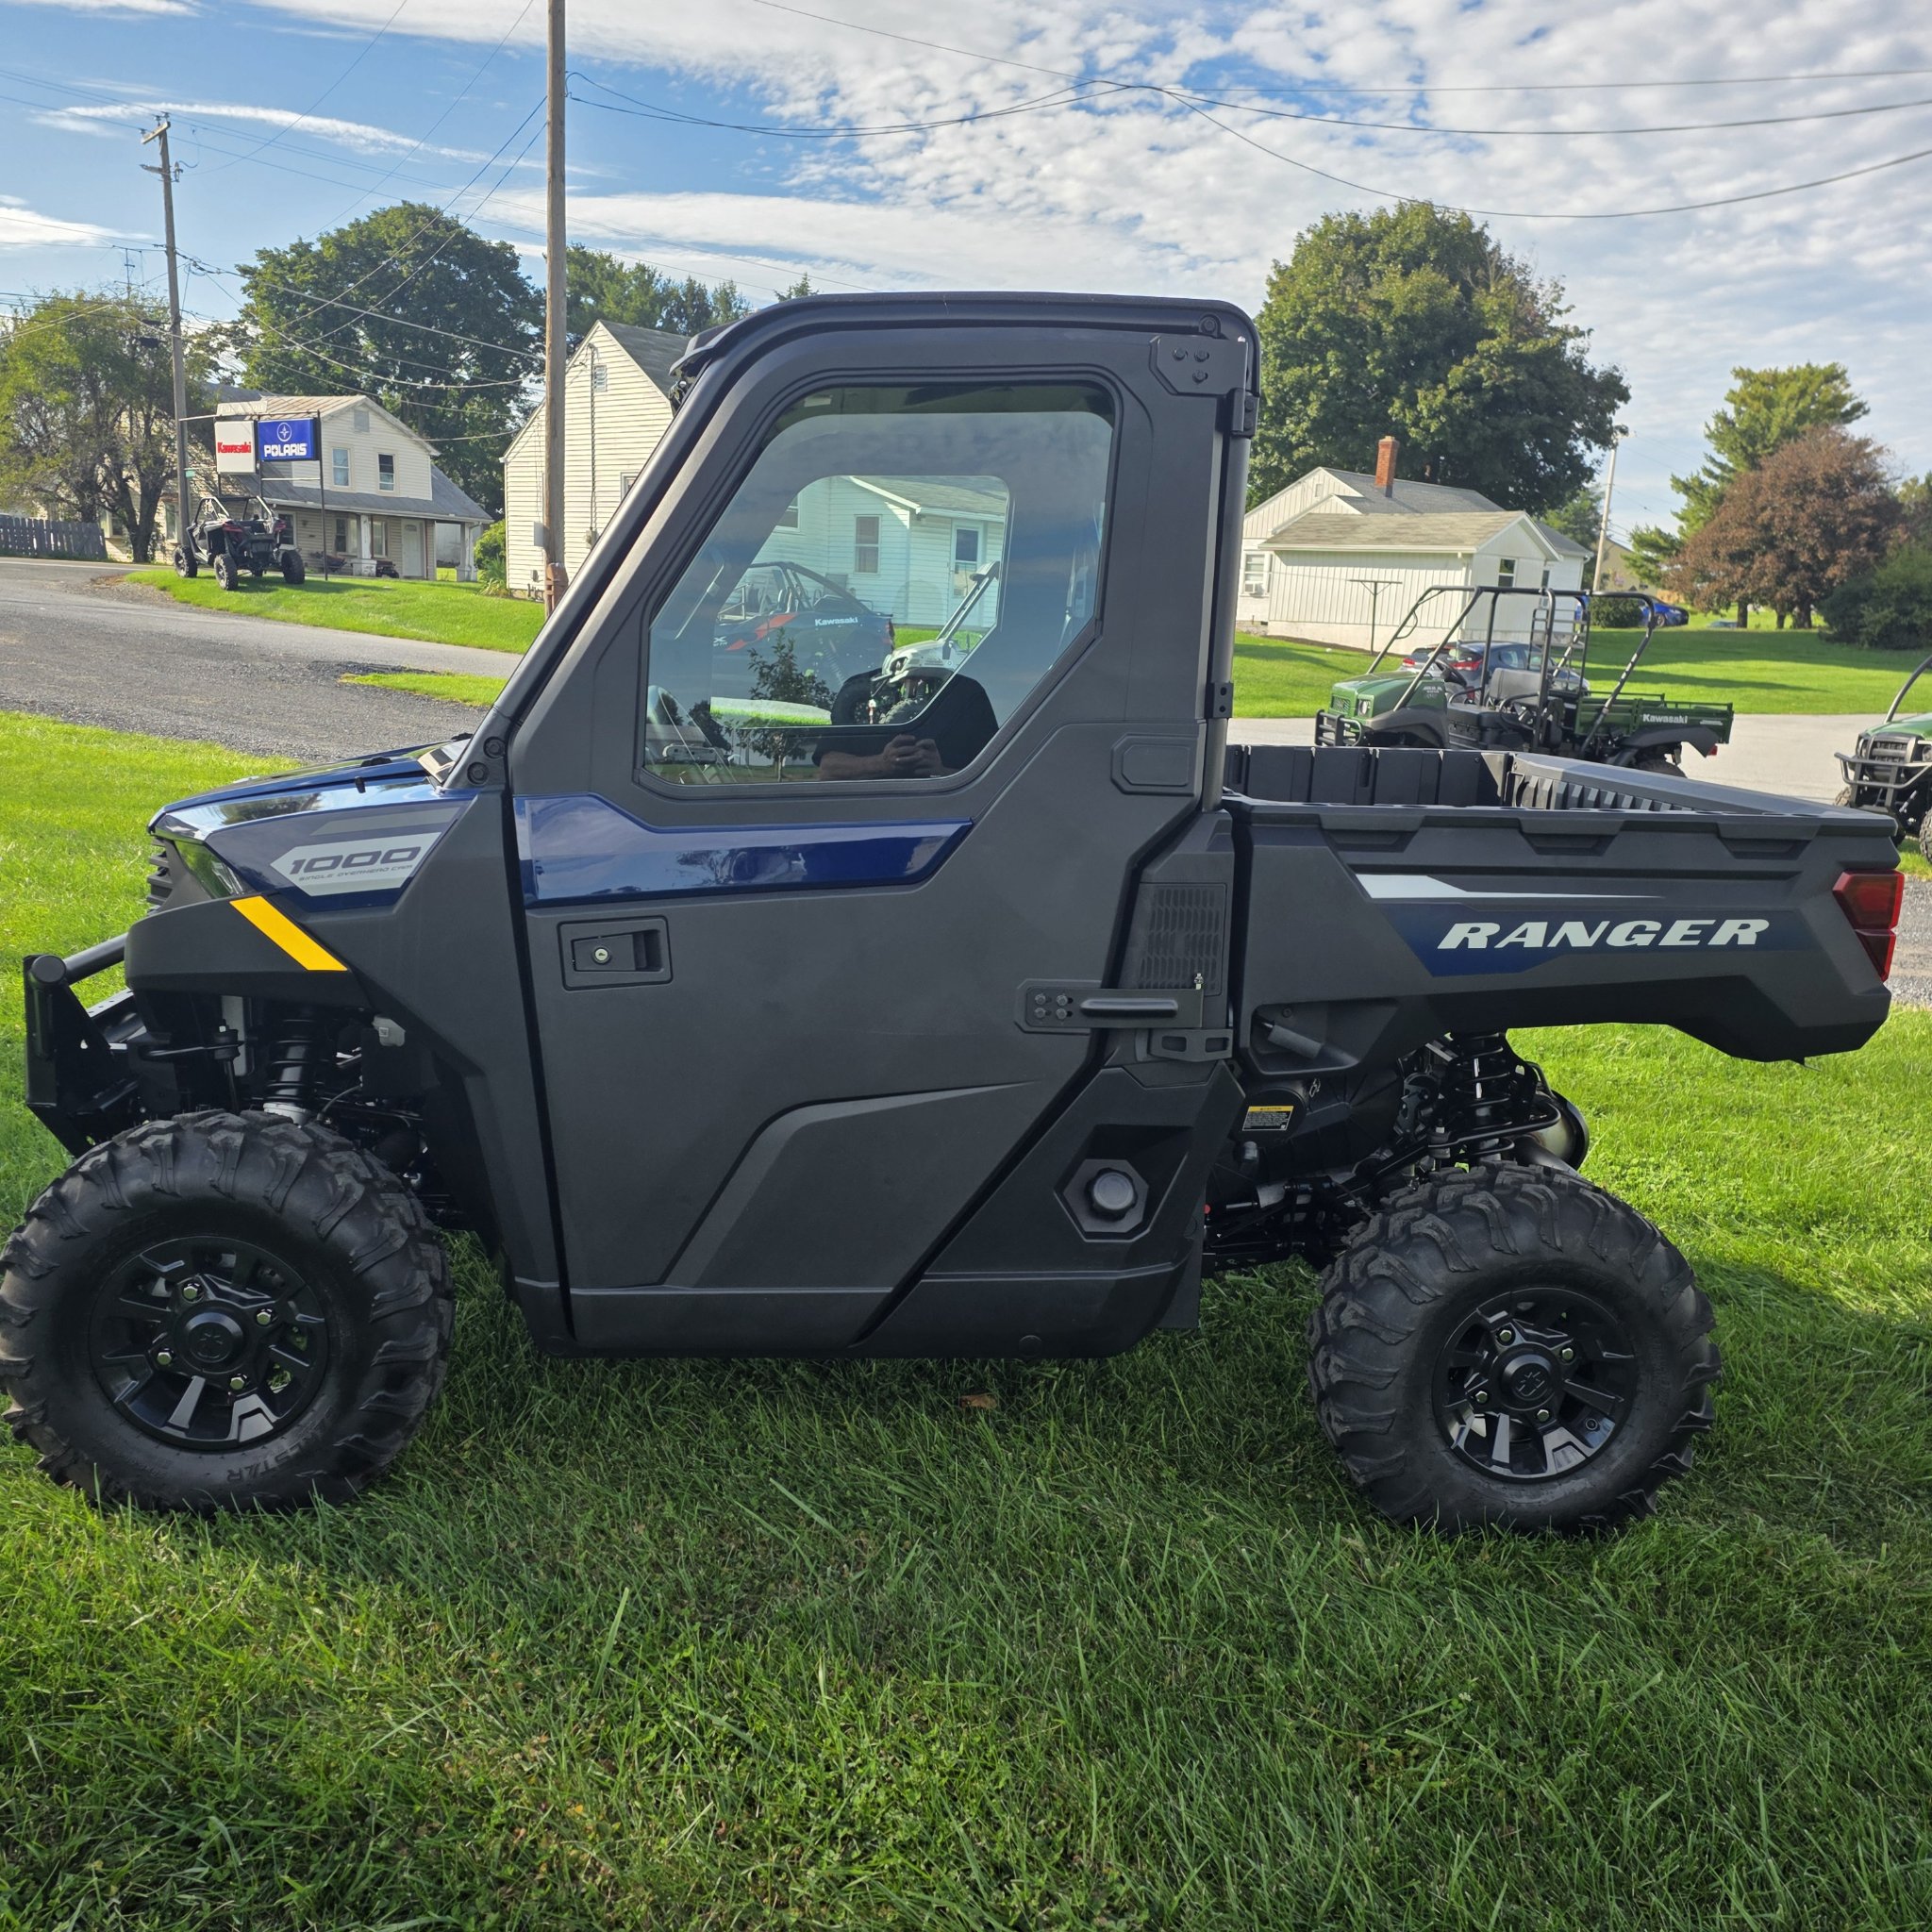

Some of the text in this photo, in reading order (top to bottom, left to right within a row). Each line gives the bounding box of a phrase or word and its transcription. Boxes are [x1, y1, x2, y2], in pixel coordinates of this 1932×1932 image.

[217, 441, 251, 453] Kawasaki
[264, 443, 307, 458] POLARIS
[814, 616, 858, 626] Kawasaki
[1642, 713, 1689, 724] Kawasaki
[290, 847, 422, 874] 1000
[298, 873, 333, 882] SINGLE
[1437, 919, 1770, 950] RANGER
